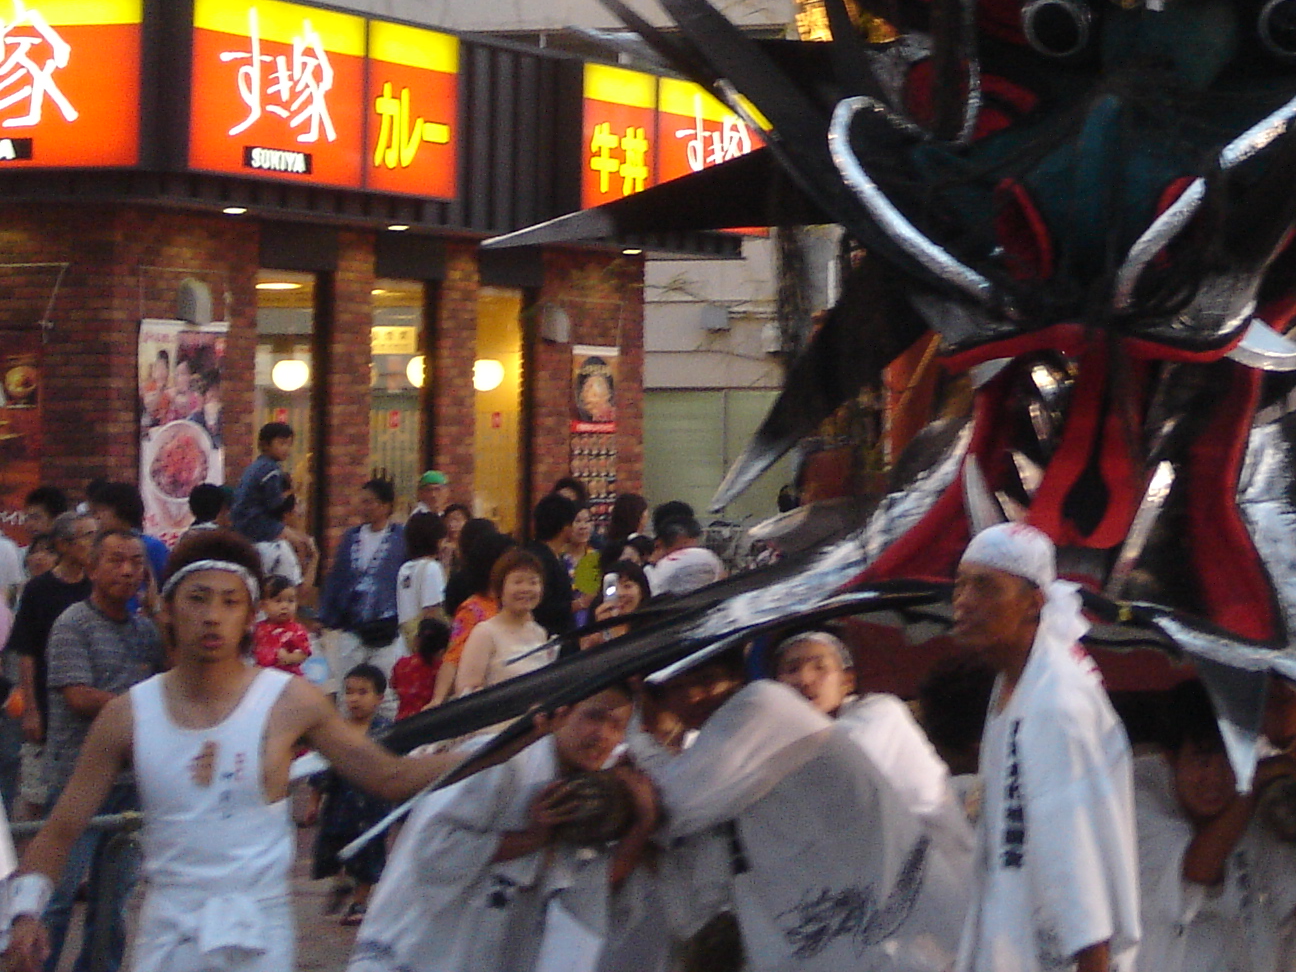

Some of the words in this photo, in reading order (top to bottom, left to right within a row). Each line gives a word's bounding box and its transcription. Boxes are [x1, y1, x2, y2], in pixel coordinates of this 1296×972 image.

[220, 7, 337, 142] すき家
[251, 147, 307, 174] SUKIYA
[374, 81, 450, 170] カレー
[590, 122, 650, 196] 牛丼
